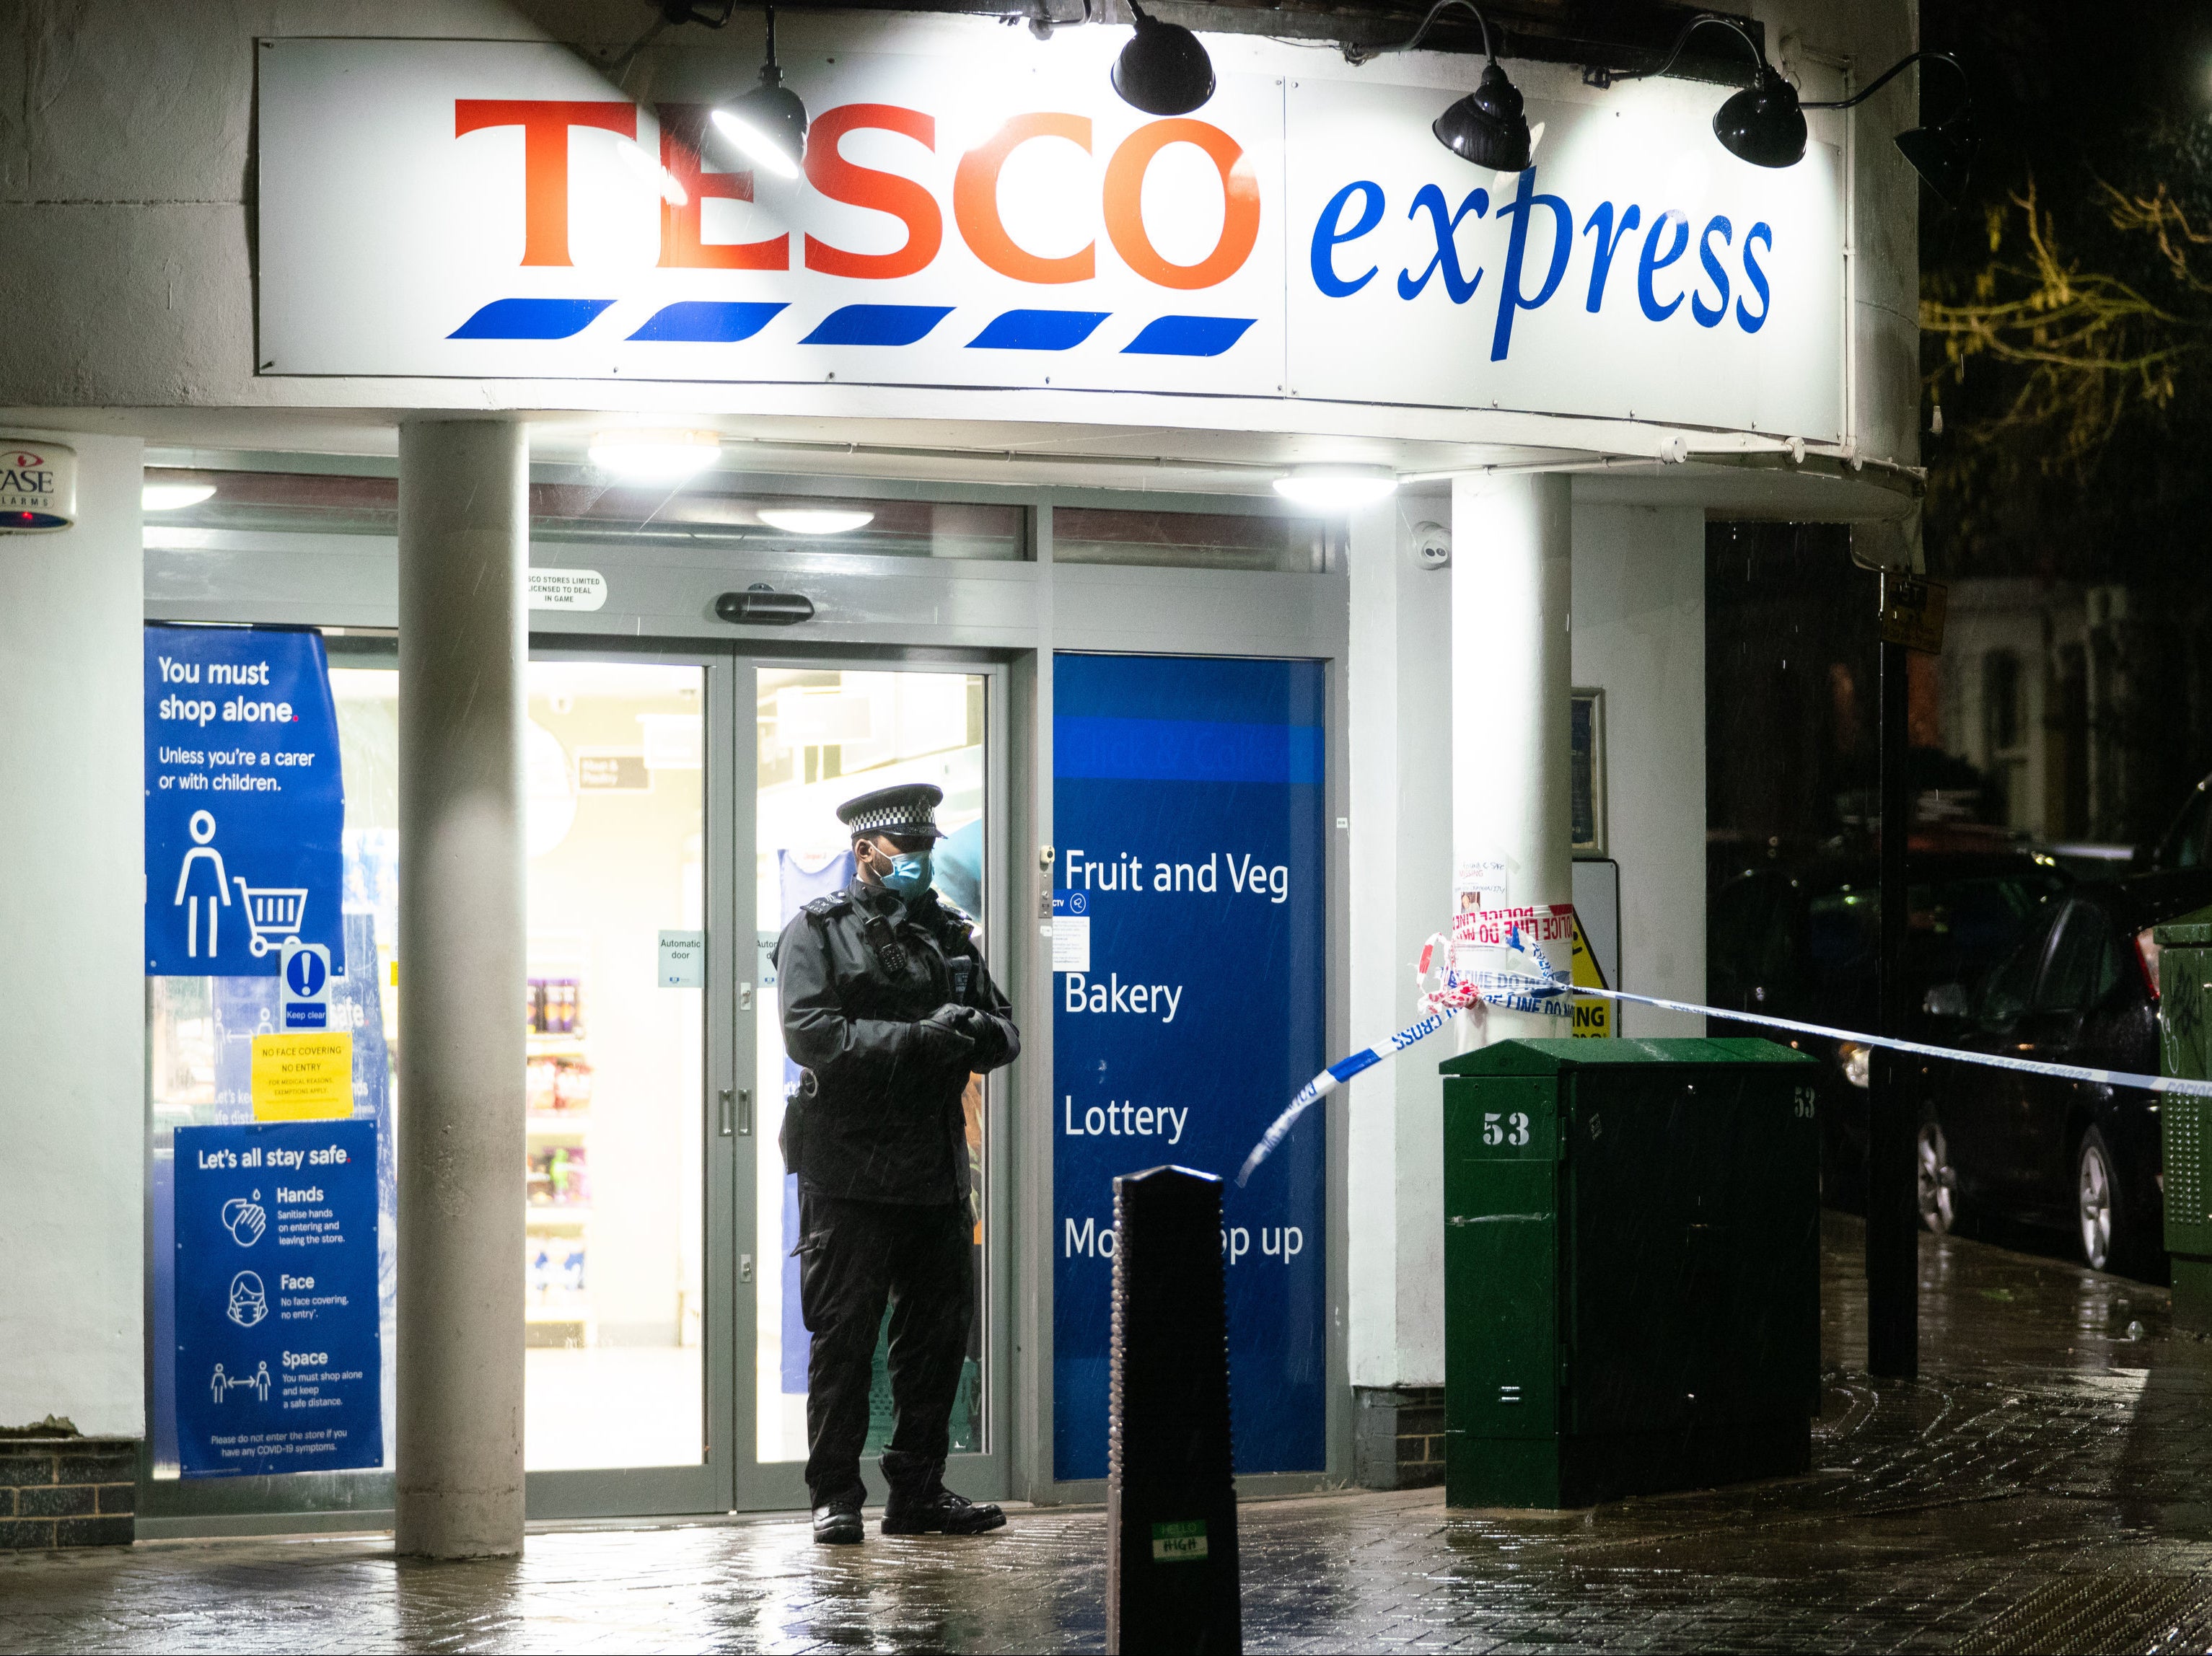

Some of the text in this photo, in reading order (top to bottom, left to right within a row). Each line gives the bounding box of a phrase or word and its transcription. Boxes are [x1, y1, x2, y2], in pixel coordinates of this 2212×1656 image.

[455, 99, 1773, 361] TESCO express
[0, 470, 54, 493] ASE
[0, 496, 48, 506] LARMS
[159, 656, 270, 685] You must
[159, 694, 299, 727] shop alone.
[159, 746, 204, 765] Unless
[260, 752, 270, 765] a
[275, 752, 315, 766] carer
[159, 772, 281, 790] or with children.
[1066, 850, 1288, 904] Fruit and Veg
[661, 938, 701, 948] Automatic
[672, 951, 690, 959] door
[1066, 972, 1182, 1023] Bakery
[287, 1011, 306, 1020] Keep
[276, 1047, 296, 1056] FACE
[299, 1046, 341, 1055] COVERING
[282, 1063, 321, 1073] NO ENTRY
[1794, 1086, 1815, 1118] 53
[1066, 1095, 1188, 1145] Lottery
[1484, 1112, 1529, 1145] 53
[199, 1145, 351, 1171] Let's all stay safe.
[277, 1186, 324, 1203] Hands
[278, 1209, 333, 1220] Sanitise hands
[278, 1220, 339, 1233] on entering and
[279, 1234, 346, 1247] leaving the store.
[1263, 1225, 1304, 1265] up
[281, 1274, 315, 1291] Face
[281, 1298, 291, 1307] No
[294, 1296, 310, 1306] face
[281, 1311, 291, 1319] no
[282, 1350, 328, 1370] Space
[283, 1370, 363, 1383] You must shop alone
[283, 1386, 319, 1396] and keep
[290, 1399, 307, 1408] safe
[308, 1397, 343, 1408] distance.
[211, 1429, 347, 1445] Please do not enter the store if you
[221, 1442, 337, 1458] have any COVID-19 symptoms.
